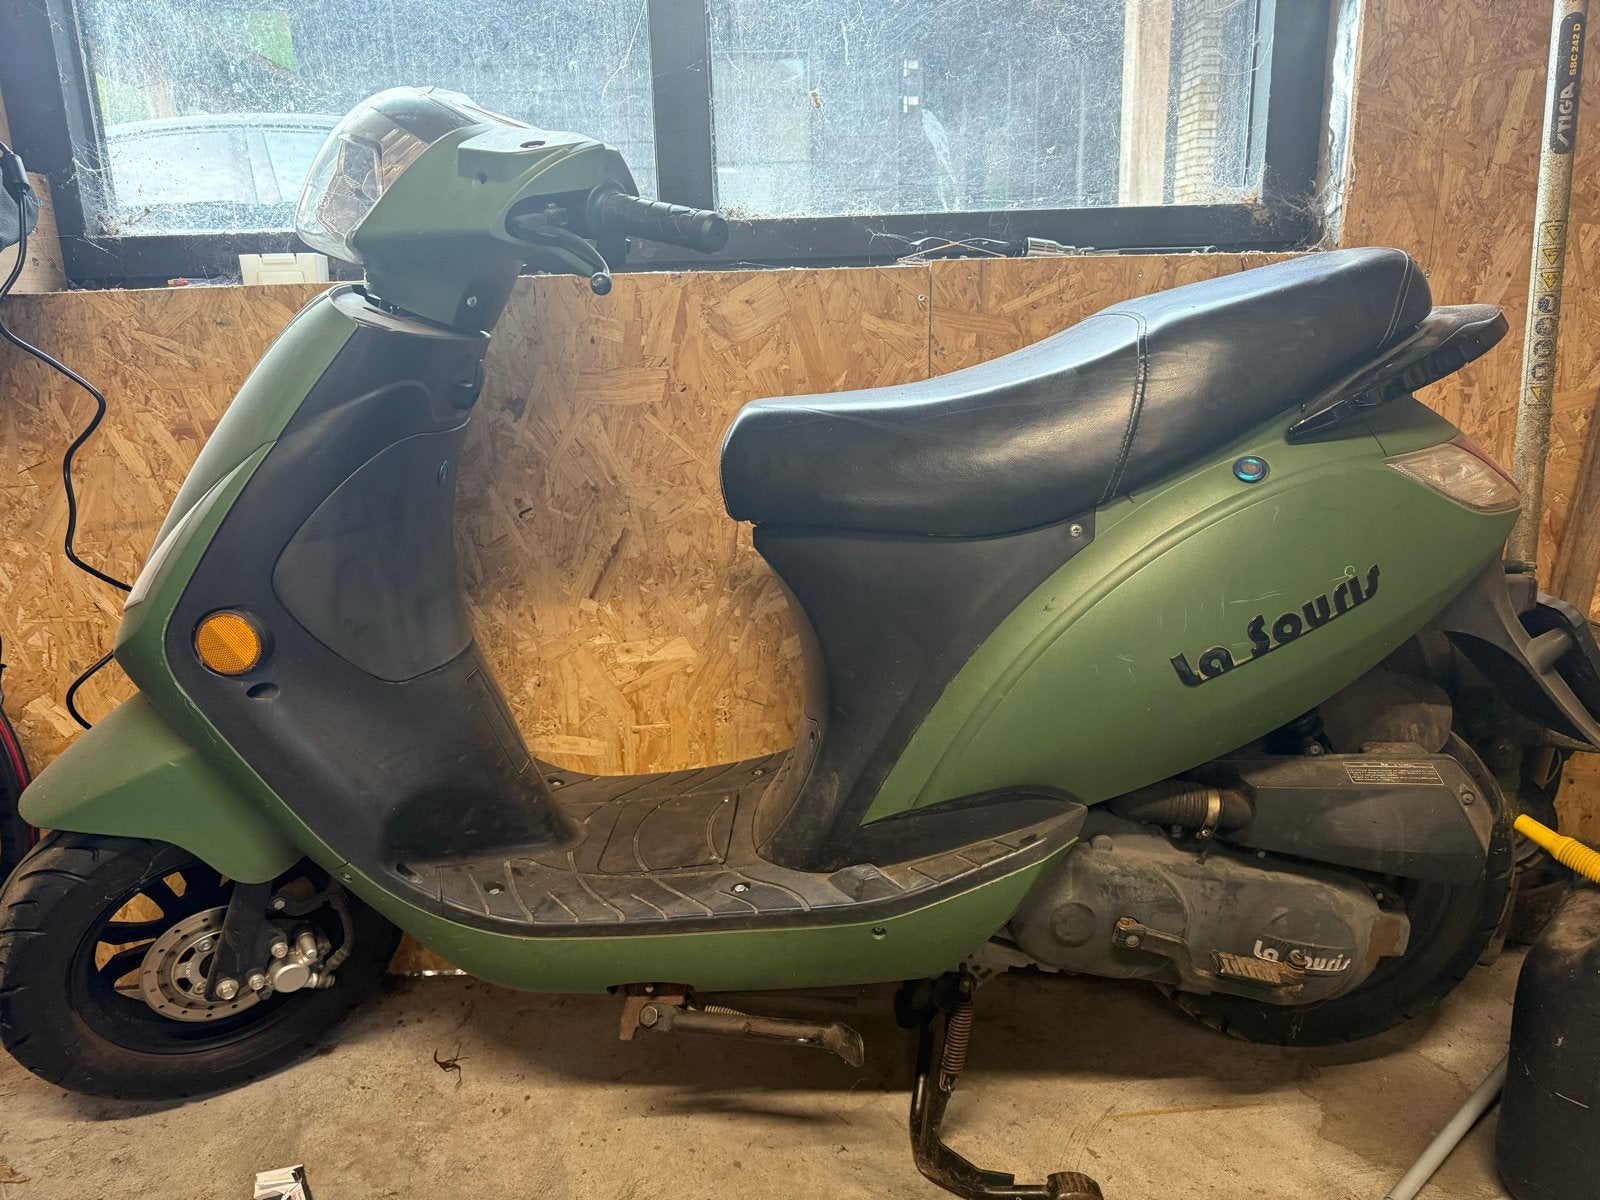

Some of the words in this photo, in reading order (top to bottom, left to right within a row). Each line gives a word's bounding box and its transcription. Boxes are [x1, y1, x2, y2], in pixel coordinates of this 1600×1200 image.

[1573, 23, 1581, 31] D
[1571, 33, 1580, 53] 242
[1569, 54, 1578, 76] SBC
[1557, 81, 1575, 147] STIGA
[1247, 563, 1381, 658] Souris
